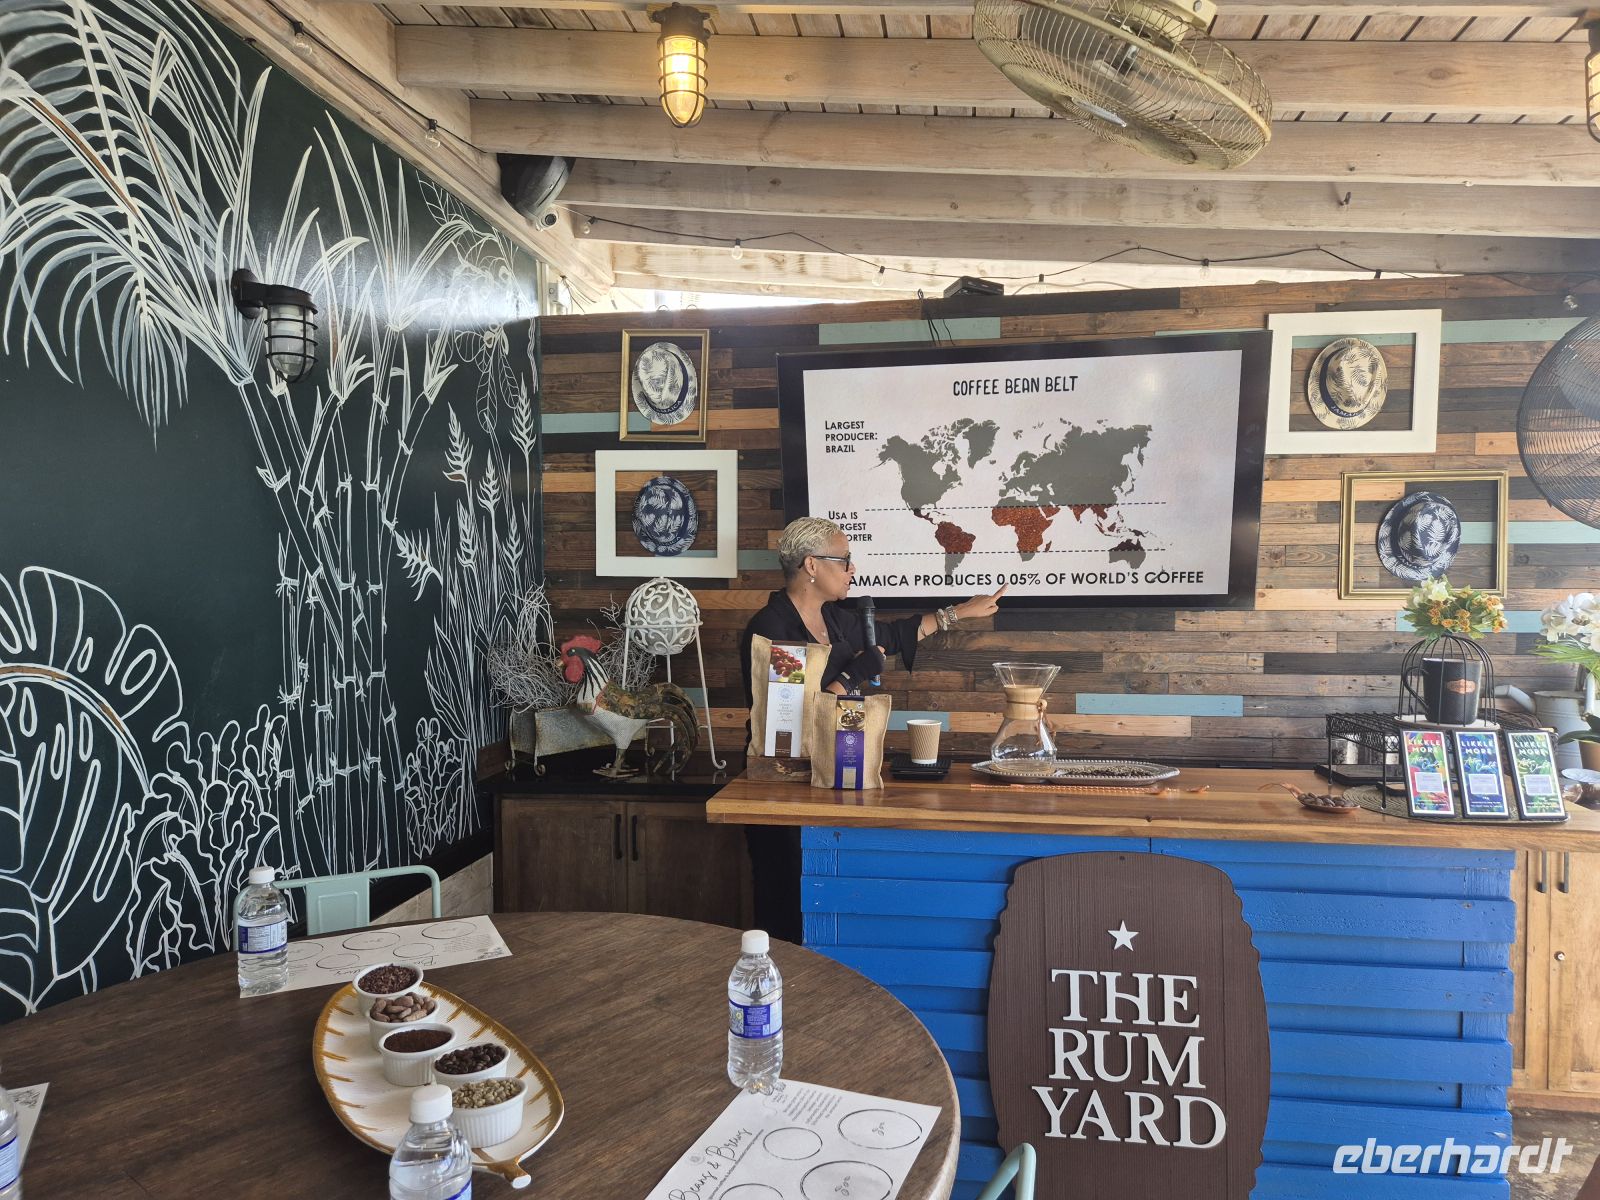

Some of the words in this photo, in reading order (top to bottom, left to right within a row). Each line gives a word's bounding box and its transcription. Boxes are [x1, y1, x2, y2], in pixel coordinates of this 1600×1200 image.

[953, 379, 1000, 396] COFFEE
[1005, 377, 1040, 394] BEAN
[1045, 375, 1078, 392] BELT
[825, 420, 865, 430] LARGEST
[825, 432, 878, 442] PRODUCER:
[825, 444, 856, 453] BRAZIL
[839, 522, 866, 531] RGEST
[846, 533, 872, 542] ORTER
[849, 574, 909, 587] AMAICA
[914, 574, 992, 586] PRODUCES
[996, 573, 1041, 586] 005%
[1045, 572, 1066, 585] OF
[1070, 571, 1139, 584] WORLD'S
[1144, 570, 1204, 585] COFFEE
[1051, 969, 1200, 1028] THE
[1048, 1027, 1206, 1088] RUM
[1031, 1085, 1227, 1149] YARD
